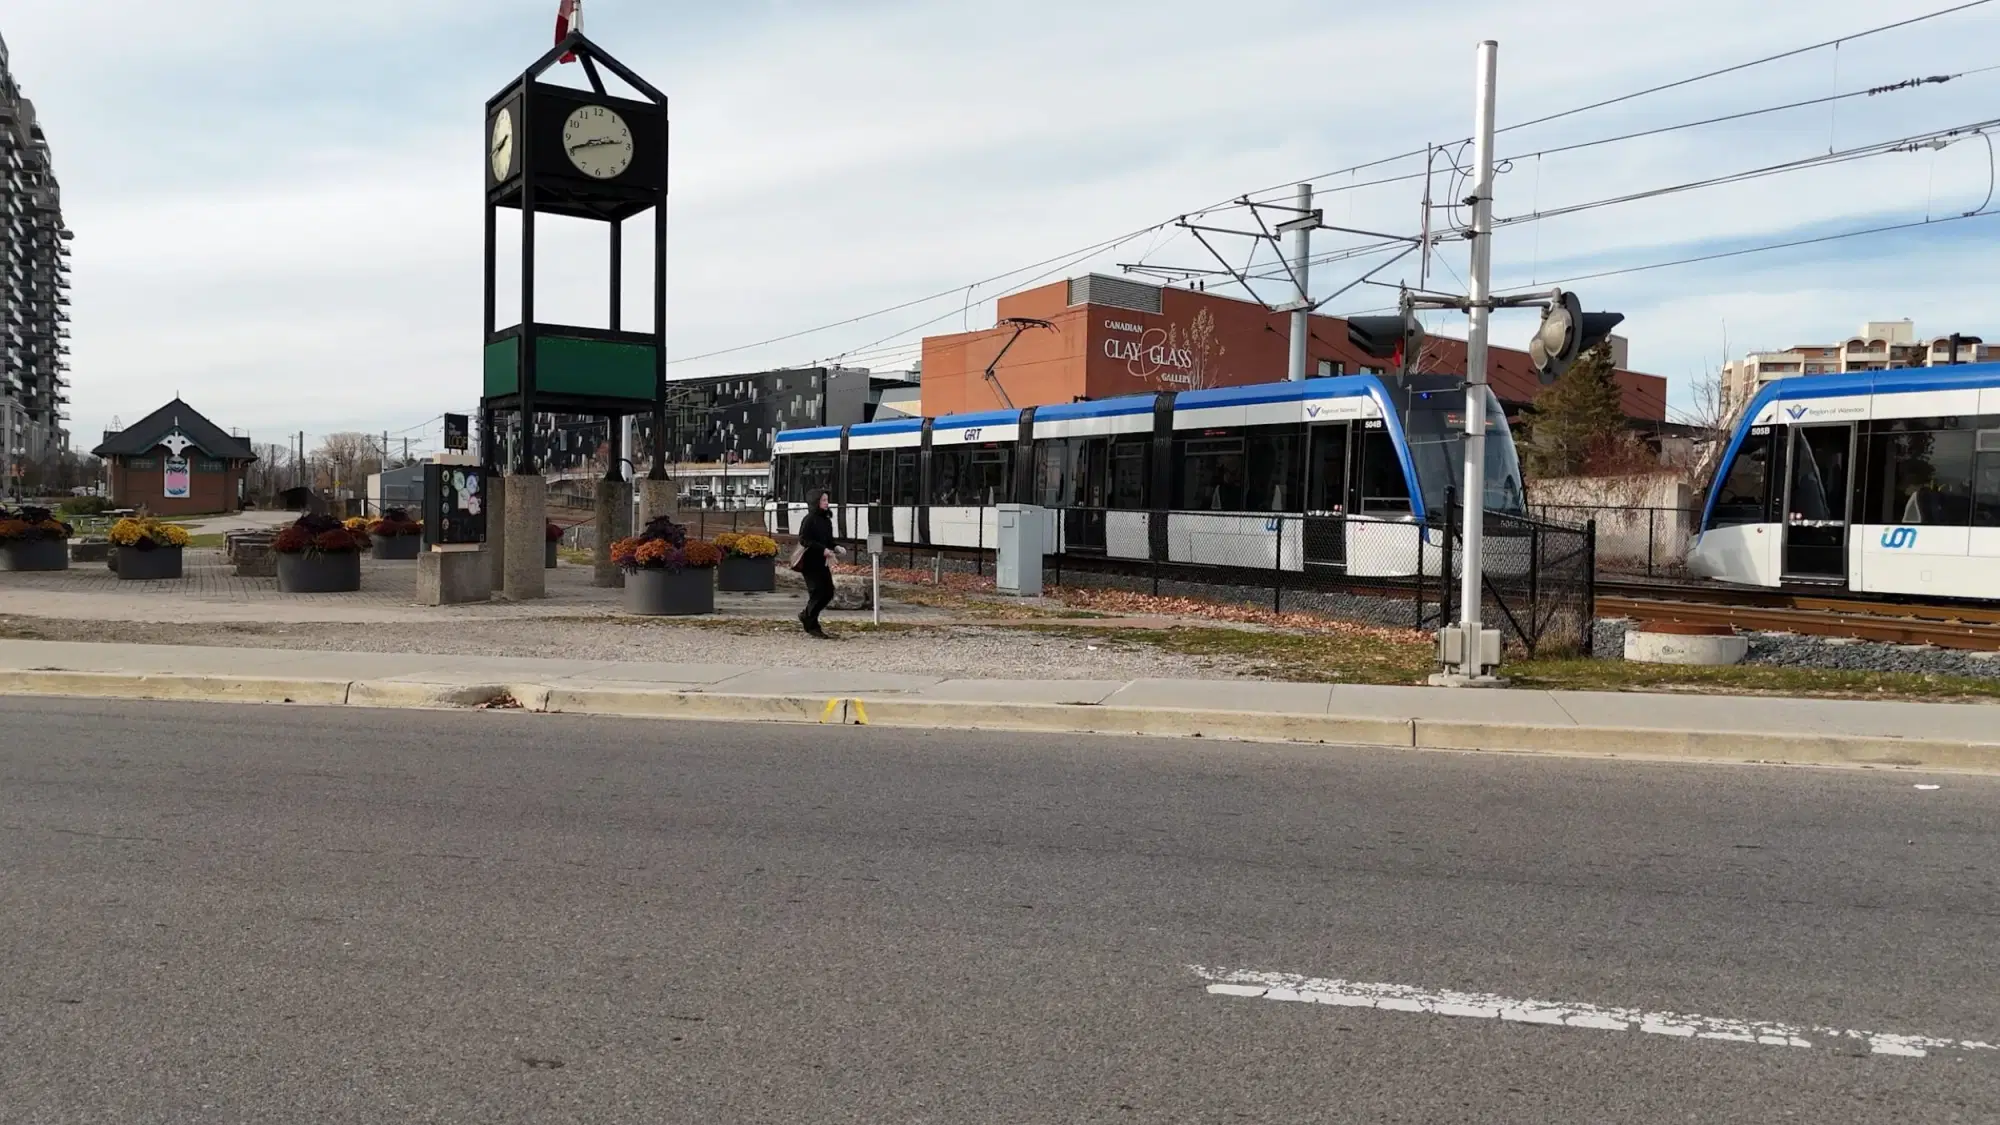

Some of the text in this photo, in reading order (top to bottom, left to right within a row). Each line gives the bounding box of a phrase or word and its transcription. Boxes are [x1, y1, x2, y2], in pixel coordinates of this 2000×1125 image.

[579, 110, 589, 120] 11
[594, 107, 604, 117] 12
[569, 119, 580, 129] 10
[1104, 319, 1143, 334] CANADIAN
[1104, 338, 1141, 361] CLAY
[1149, 345, 1192, 368] GLASS
[1161, 372, 1191, 384] GALLERY
[1364, 420, 1382, 429] 504B
[964, 428, 982, 441] GRT
[1751, 427, 1770, 436] 505B
